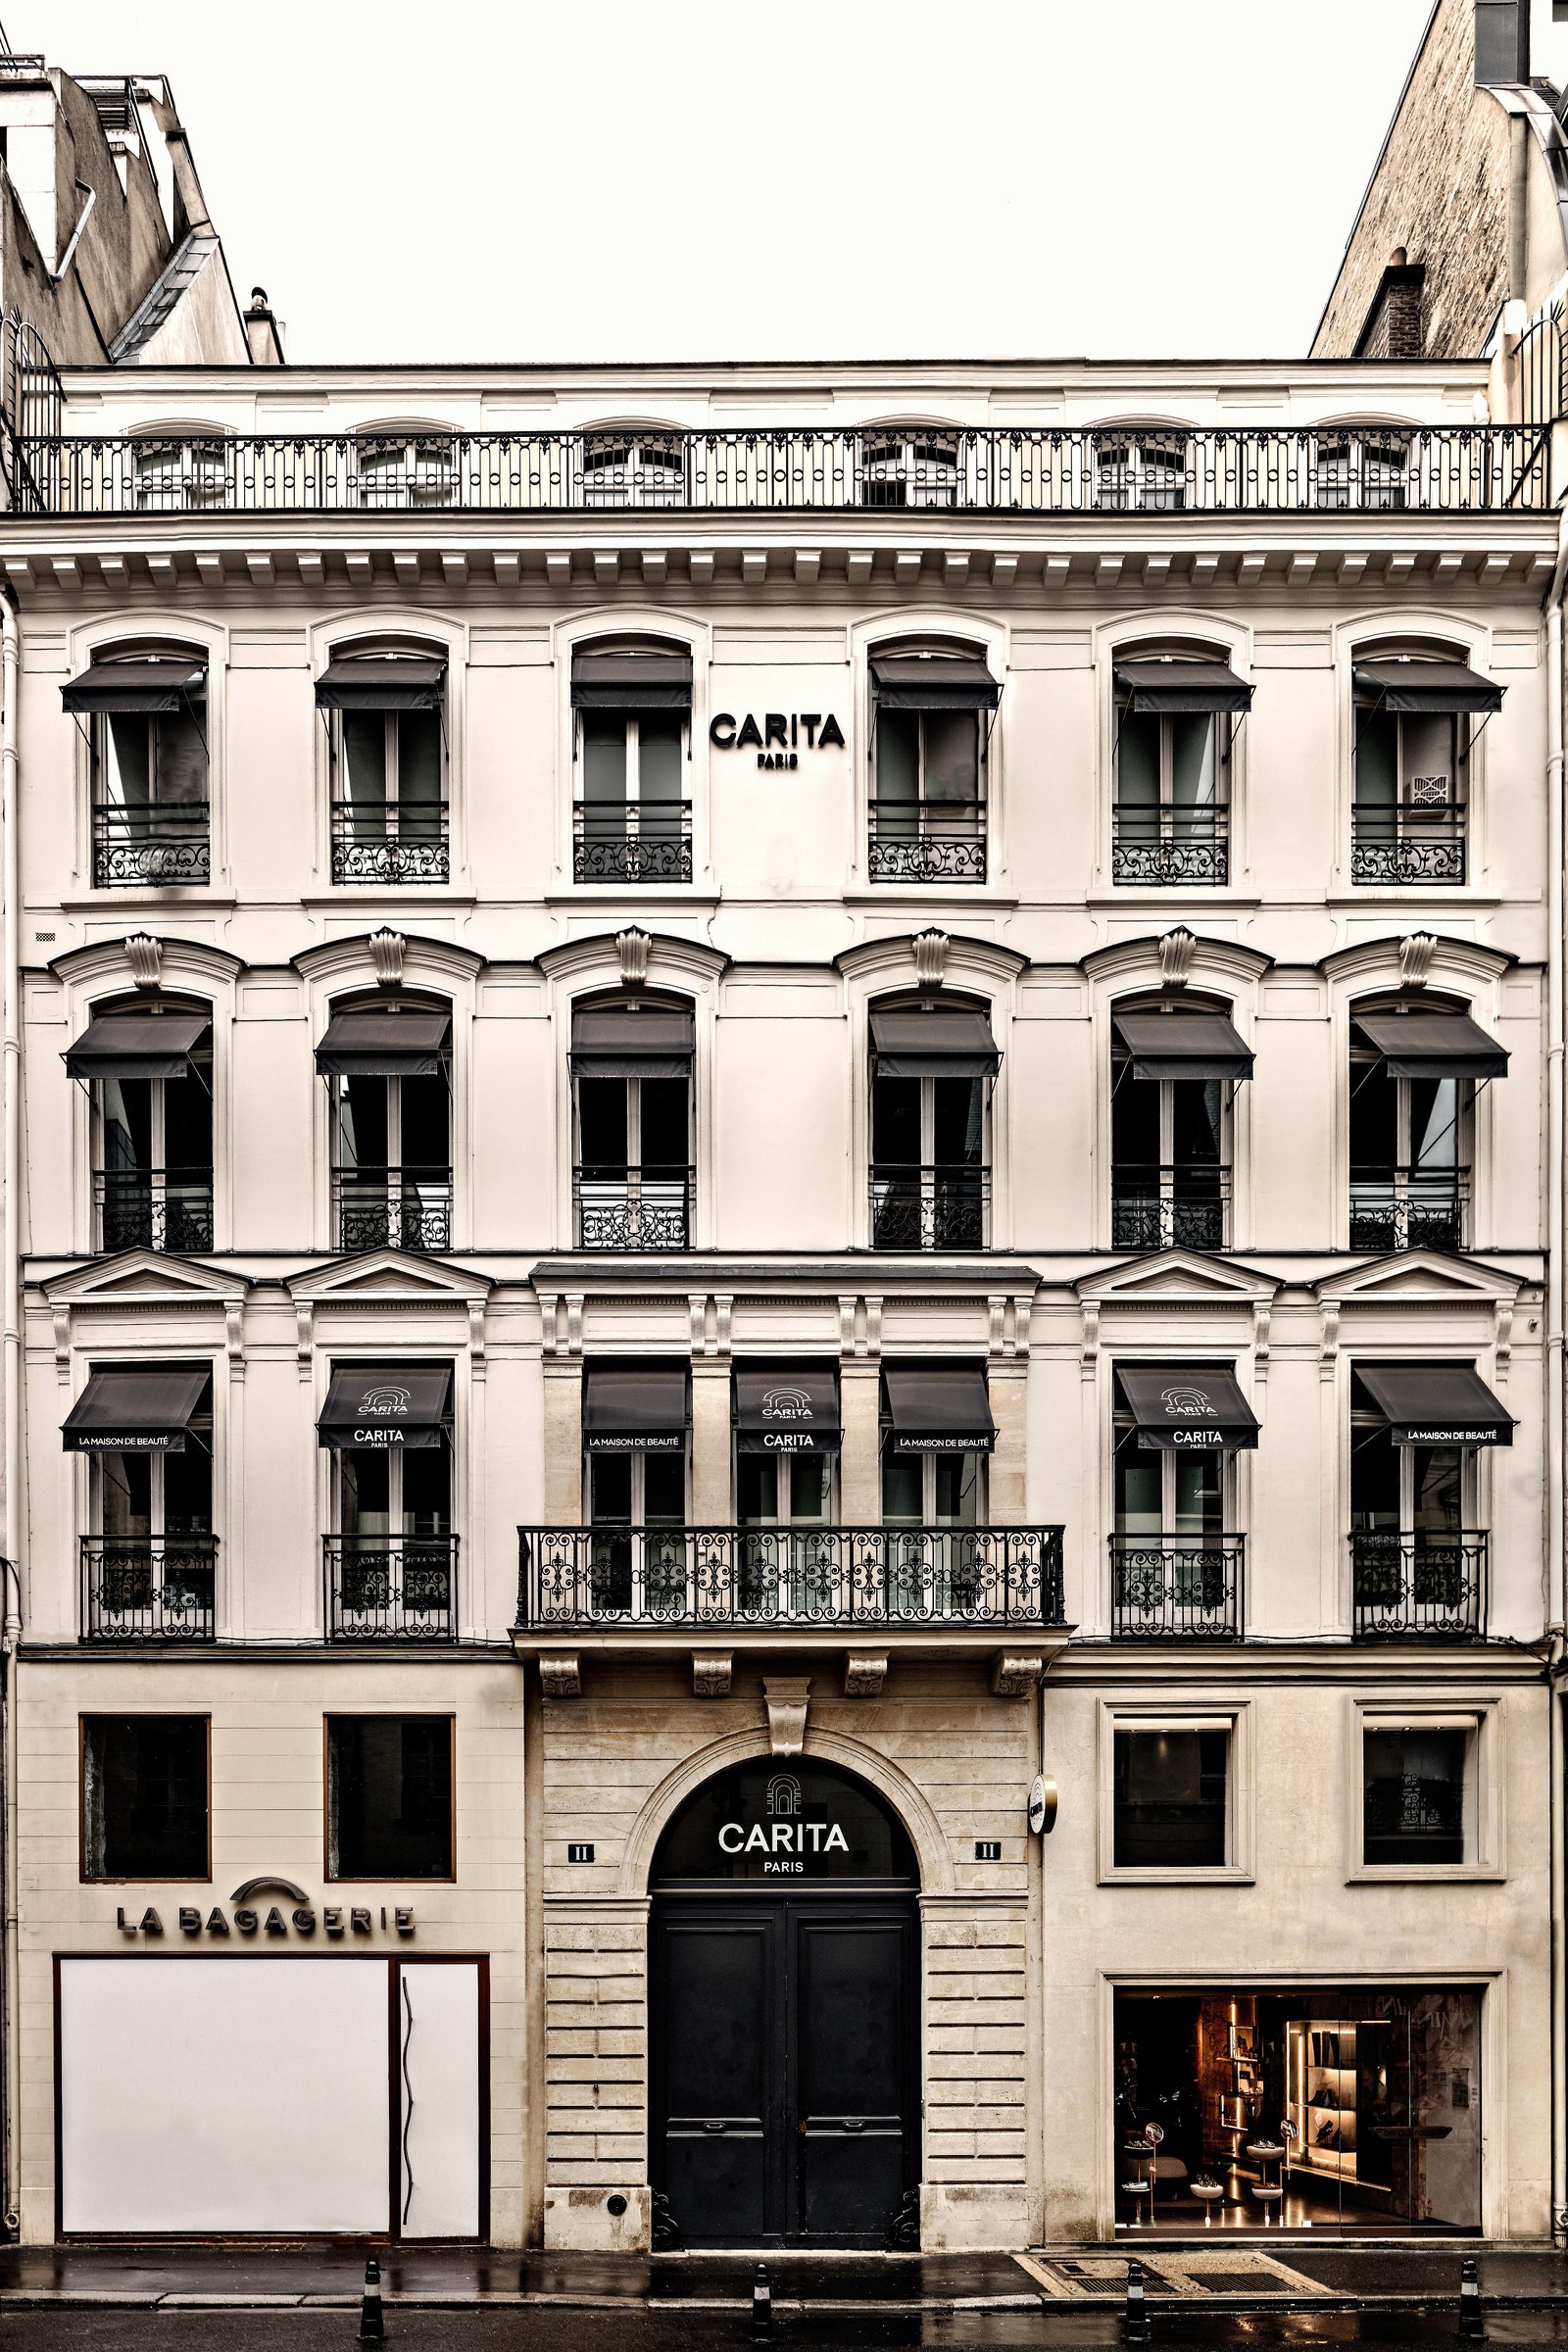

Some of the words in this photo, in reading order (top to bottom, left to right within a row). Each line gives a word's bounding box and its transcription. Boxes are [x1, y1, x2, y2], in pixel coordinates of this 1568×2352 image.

[710, 713, 845, 747] CARITA
[758, 754, 798, 768] PARIS
[137, 1435, 169, 1445] BEAUTÉ
[354, 1429, 405, 1442] CARITA
[763, 1434, 813, 1446] CARITA
[1173, 1431, 1223, 1443] CARITA
[1419, 1431, 1451, 1440] MAISON
[1452, 1431, 1464, 1440] DE
[1465, 1429, 1496, 1439] BEAUTÉ
[647, 1436, 678, 1446] BEAUTÉ
[957, 1437, 989, 1446] BEAUTÉ
[718, 1823, 850, 1853] CARITA
[764, 1862, 804, 1872] PARIS
[117, 1906, 164, 1931] LA
[178, 1906, 416, 1931] BAGAGERIE
